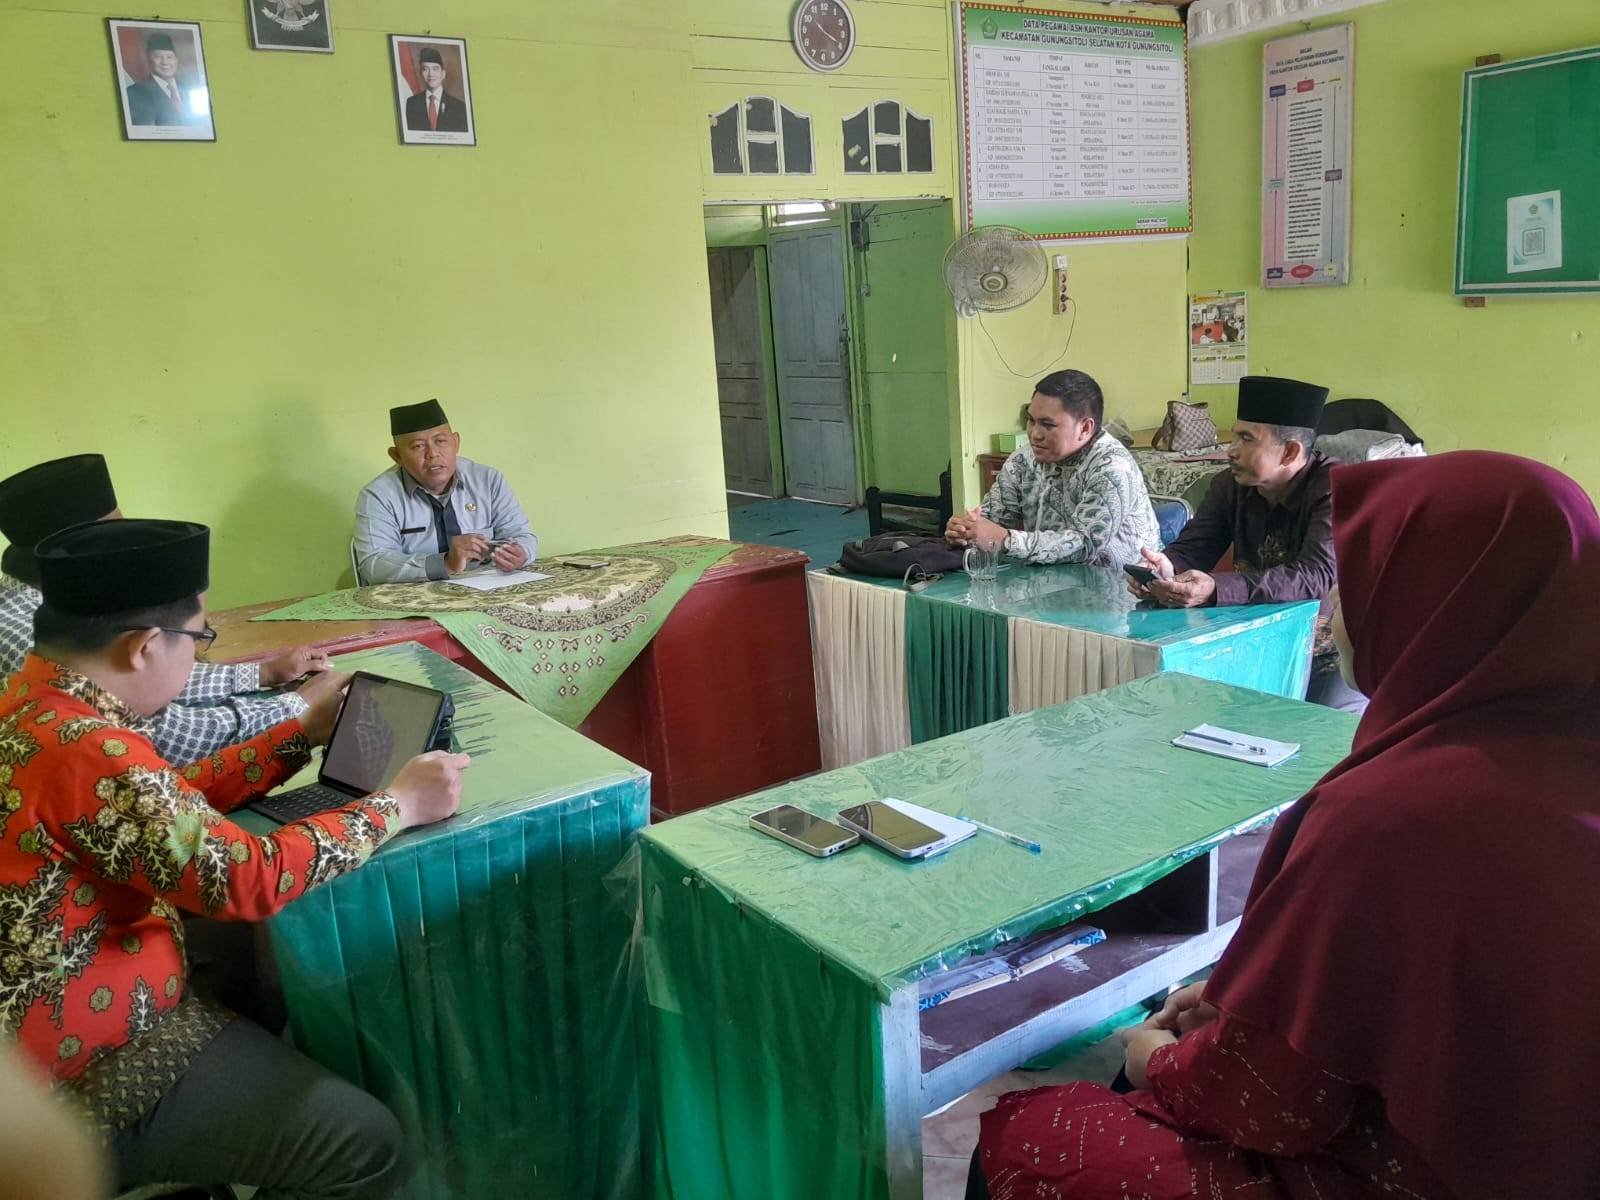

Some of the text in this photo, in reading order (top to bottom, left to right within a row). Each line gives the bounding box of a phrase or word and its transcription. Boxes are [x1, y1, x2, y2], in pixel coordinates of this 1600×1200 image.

[811, 5, 817, 13] 11
[820, 2, 829, 11] 12
[804, 14, 813, 23] 10
[838, 18, 843, 26] 2
[1023, 19, 1154, 38] DATA PEGAWAI ASN KANTOR URUSAN AGAMA
[1001, 31, 1174, 53] KECAMATAN GUNUNGSITOLI SELATAN KOTA GUNUNGSITOLI
[811, 49, 816, 57] 7
